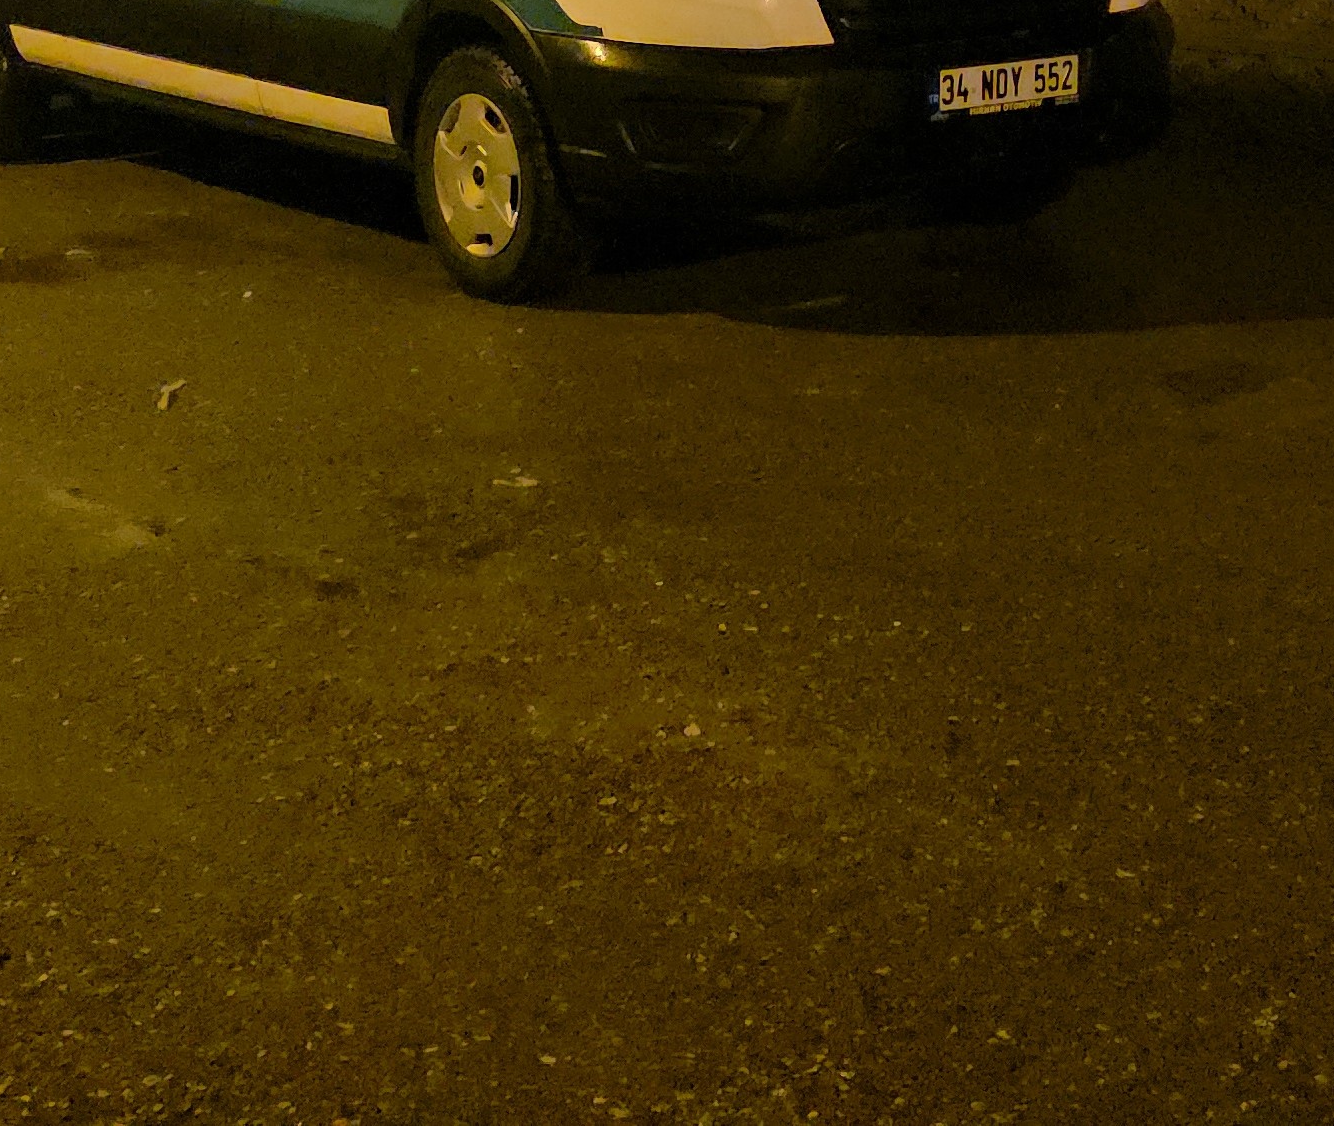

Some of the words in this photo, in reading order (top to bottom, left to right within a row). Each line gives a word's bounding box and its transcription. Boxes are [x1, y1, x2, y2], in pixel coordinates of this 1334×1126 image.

[941, 73, 969, 106] 34
[981, 66, 1023, 101] NDY
[1034, 60, 1074, 93] 552
